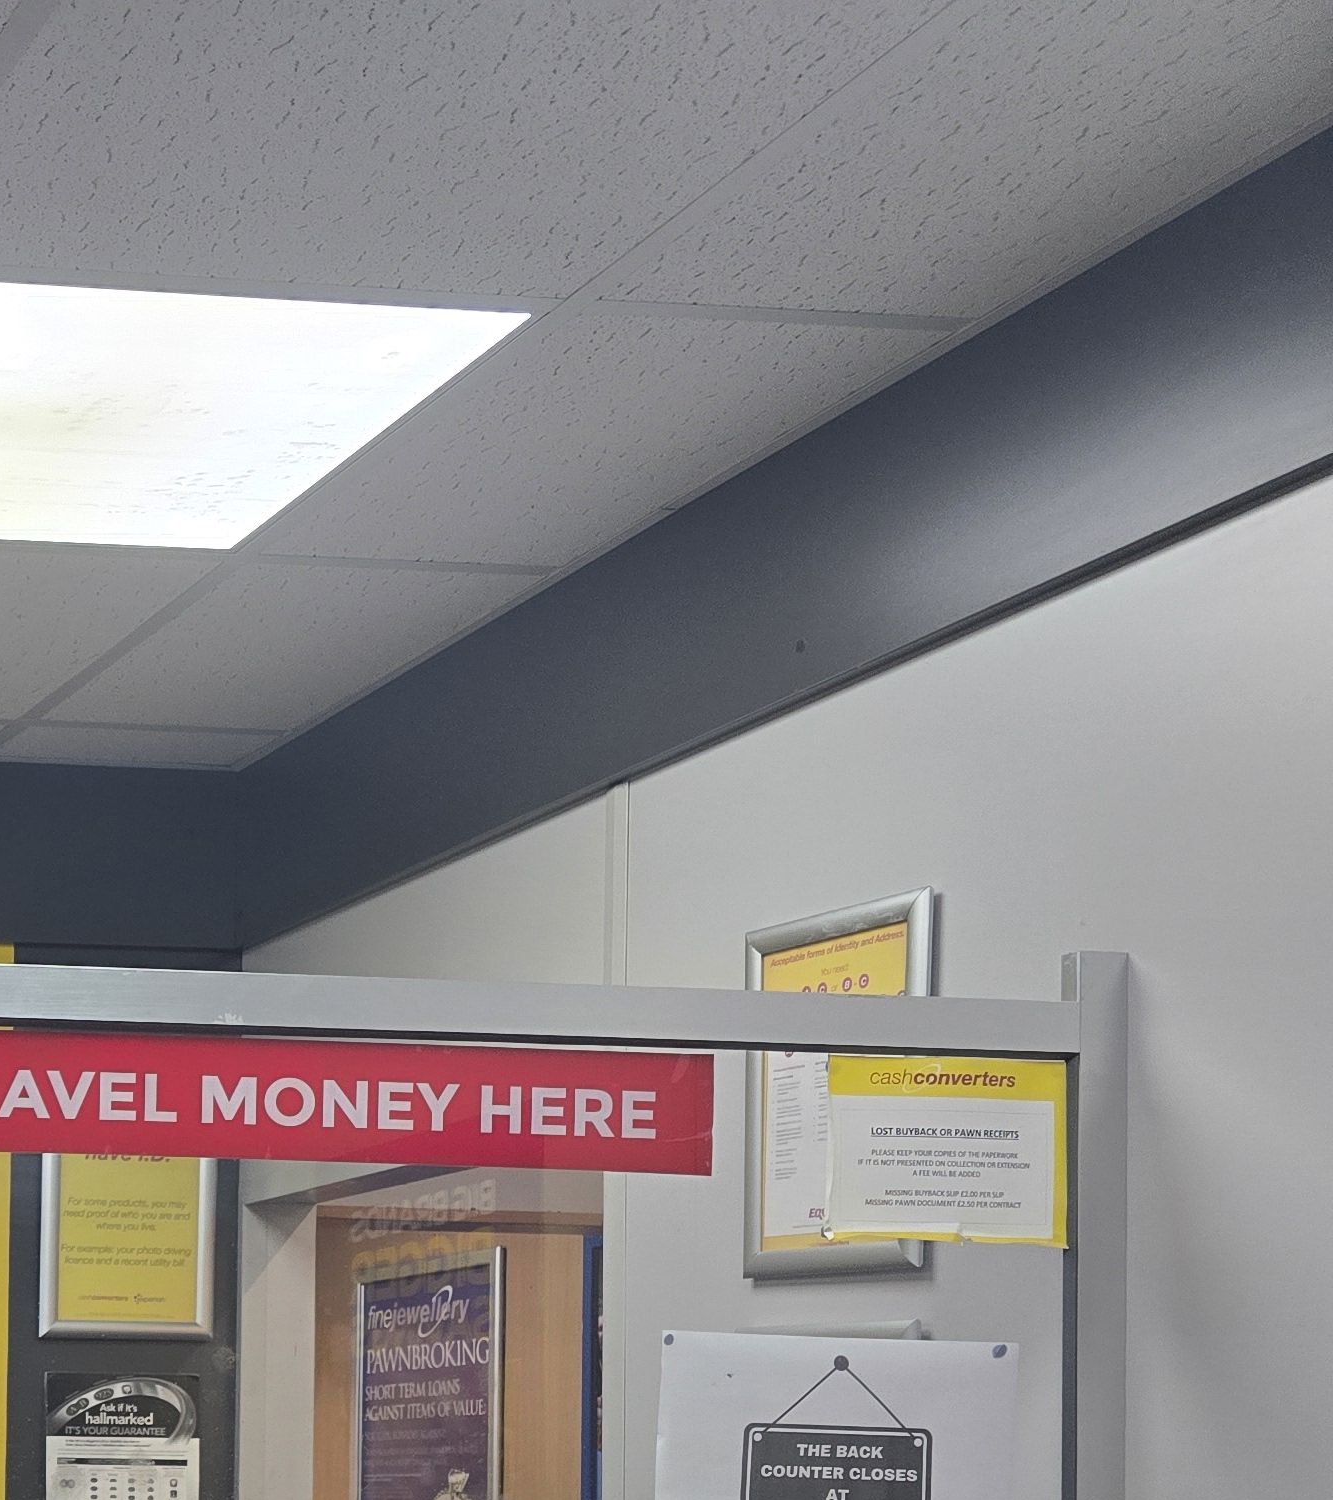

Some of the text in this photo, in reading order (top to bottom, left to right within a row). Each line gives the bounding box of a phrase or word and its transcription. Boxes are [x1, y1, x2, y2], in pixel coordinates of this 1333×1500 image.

[870, 1067, 1016, 1088] cashconverters
[199, 1075, 460, 1132] MONEY
[479, 1085, 657, 1139] HERE
[871, 1127, 1019, 1140] LOST BUYBACK OR PAWN RECEIPTS
[366, 1336, 489, 1374] PAWNBROKING
[365, 1378, 461, 1401] SHORT TERM LOANS
[100, 1404, 116, 1412] Ask
[407, 1402, 435, 1419] ITEMS
[437, 1400, 451, 1417] OF
[85, 1412, 153, 1426] hallmarked
[83, 1426, 108, 1435] YOUR
[111, 1427, 166, 1436] GUARANTEE
[797, 1444, 883, 1458] THE BACK
[761, 1465, 919, 1482] COUNTER CLOSES
[826, 1488, 849, 1500] AT
